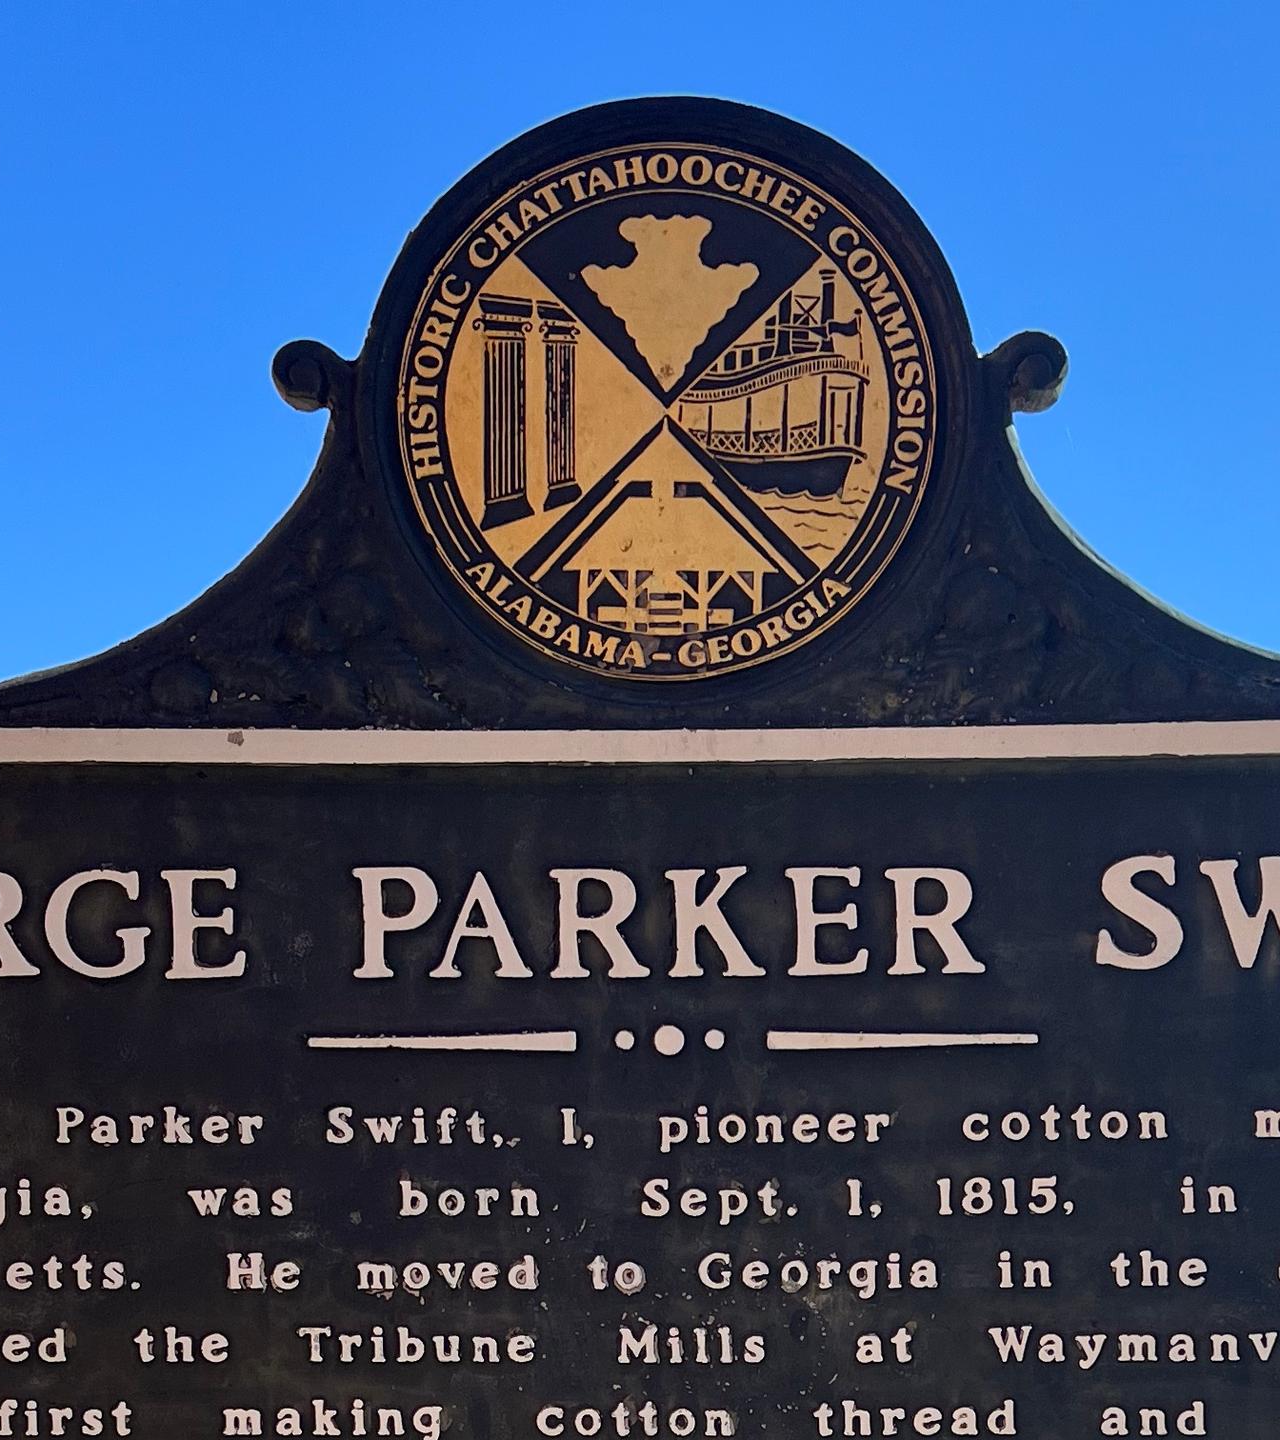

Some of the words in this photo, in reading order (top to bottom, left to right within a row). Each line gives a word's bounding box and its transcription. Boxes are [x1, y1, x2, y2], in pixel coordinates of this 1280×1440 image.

[410, 274, 472, 478] HISTORIC
[467, 153, 827, 270] CHATTAHOOCHEE
[827, 225, 928, 495] COMMISSION
[352, 865, 986, 979] PARKER
[56, 1106, 264, 1145] Parker
[326, 1106, 504, 1148] Swift,
[560, 1107, 594, 1149] I,
[658, 1105, 890, 1153] pioneer
[962, 1104, 1169, 1142] cotton
[187, 1187, 293, 1217] was
[399, 1180, 540, 1217] born
[641, 1178, 798, 1226] Sept.
[936, 1175, 1074, 1216] 1815,
[1180, 1176, 1238, 1214] in
[226, 1252, 301, 1291] He
[357, 1254, 540, 1290] moved
[586, 1255, 647, 1297] to
[697, 1252, 939, 1300] Georgia
[997, 1250, 1052, 1289] in
[1110, 1249, 1208, 1287] the
[133, 1326, 229, 1363] the
[298, 1326, 535, 1363] Tribune
[617, 1323, 765, 1364] Mills
[855, 1327, 912, 1364] at
[536, 1400, 736, 1437] cotton
[812, 1399, 1017, 1437] thread
[1100, 1400, 1207, 1436] and
